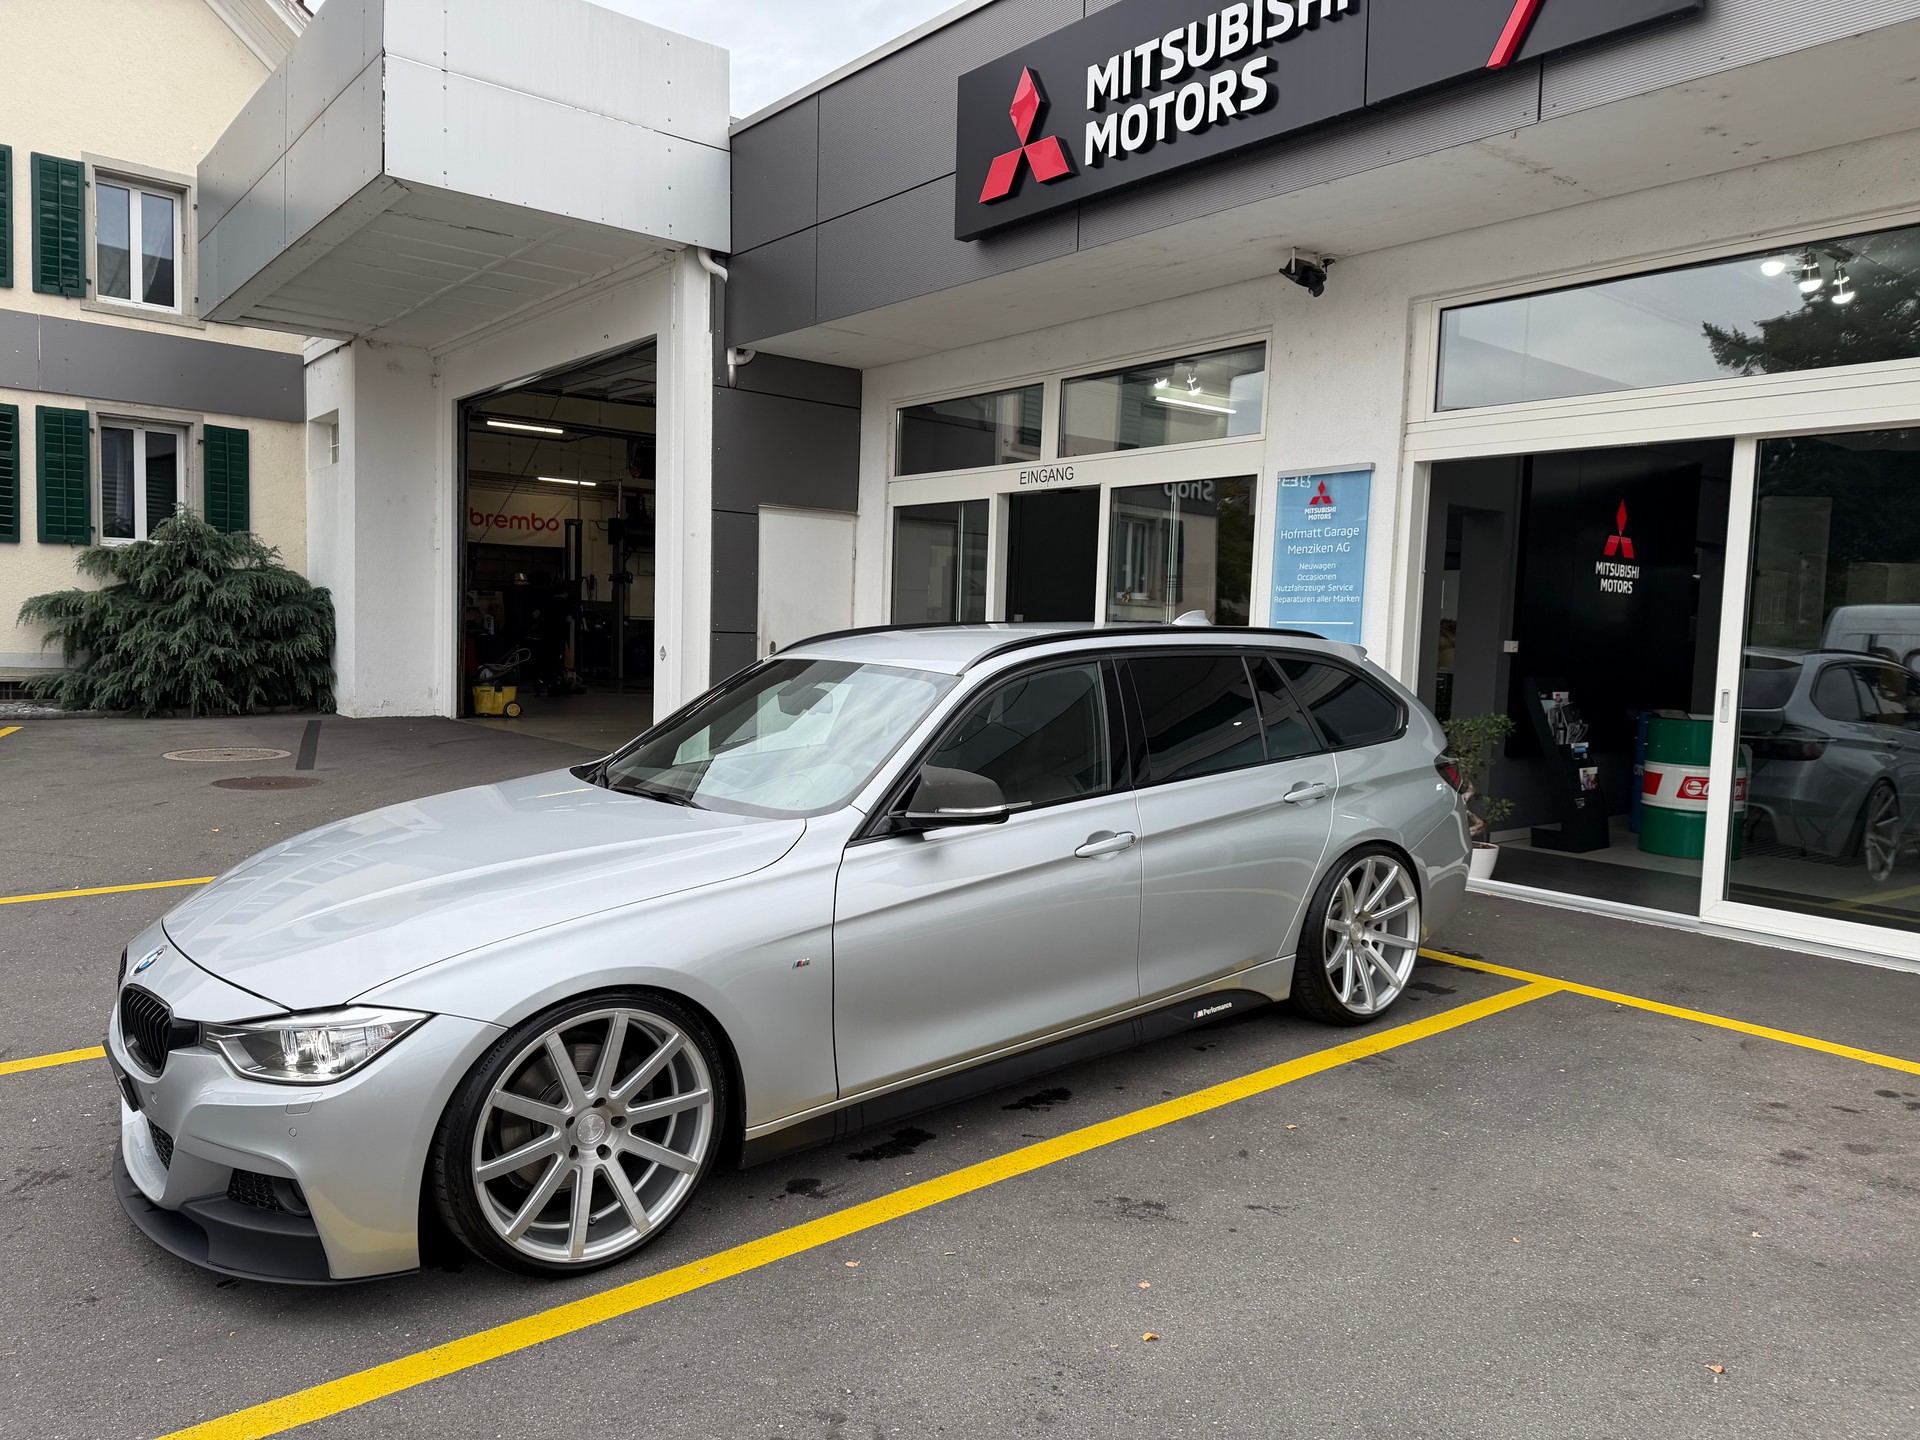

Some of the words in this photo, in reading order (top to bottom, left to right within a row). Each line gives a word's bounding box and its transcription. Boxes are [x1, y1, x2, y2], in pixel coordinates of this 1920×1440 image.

[1087, 0, 1348, 111] MITSUBIS
[1084, 57, 1268, 167] MOTORS
[1019, 466, 1075, 485] EINGANG
[1304, 506, 1336, 514] MITSUBISHI
[469, 507, 560, 532] brembo
[1308, 513, 1332, 521] MOTORS
[1281, 528, 1321, 539] Hofmatt
[1324, 527, 1360, 538] Garage
[1287, 543, 1334, 555] Menziken
[1335, 542, 1351, 553] AG
[1299, 562, 1336, 571] Neuwagen
[1595, 561, 1640, 579] MITSUBISHI
[1297, 573, 1337, 581] Occasionen
[1275, 584, 1326, 593] Nutzfahrzeuge
[1327, 584, 1354, 592] Service
[1600, 578, 1633, 594] MOTORS
[1273, 595, 1316, 604] Reparaturen
[1316, 595, 1332, 603] aller
[1332, 595, 1360, 603] Marken
